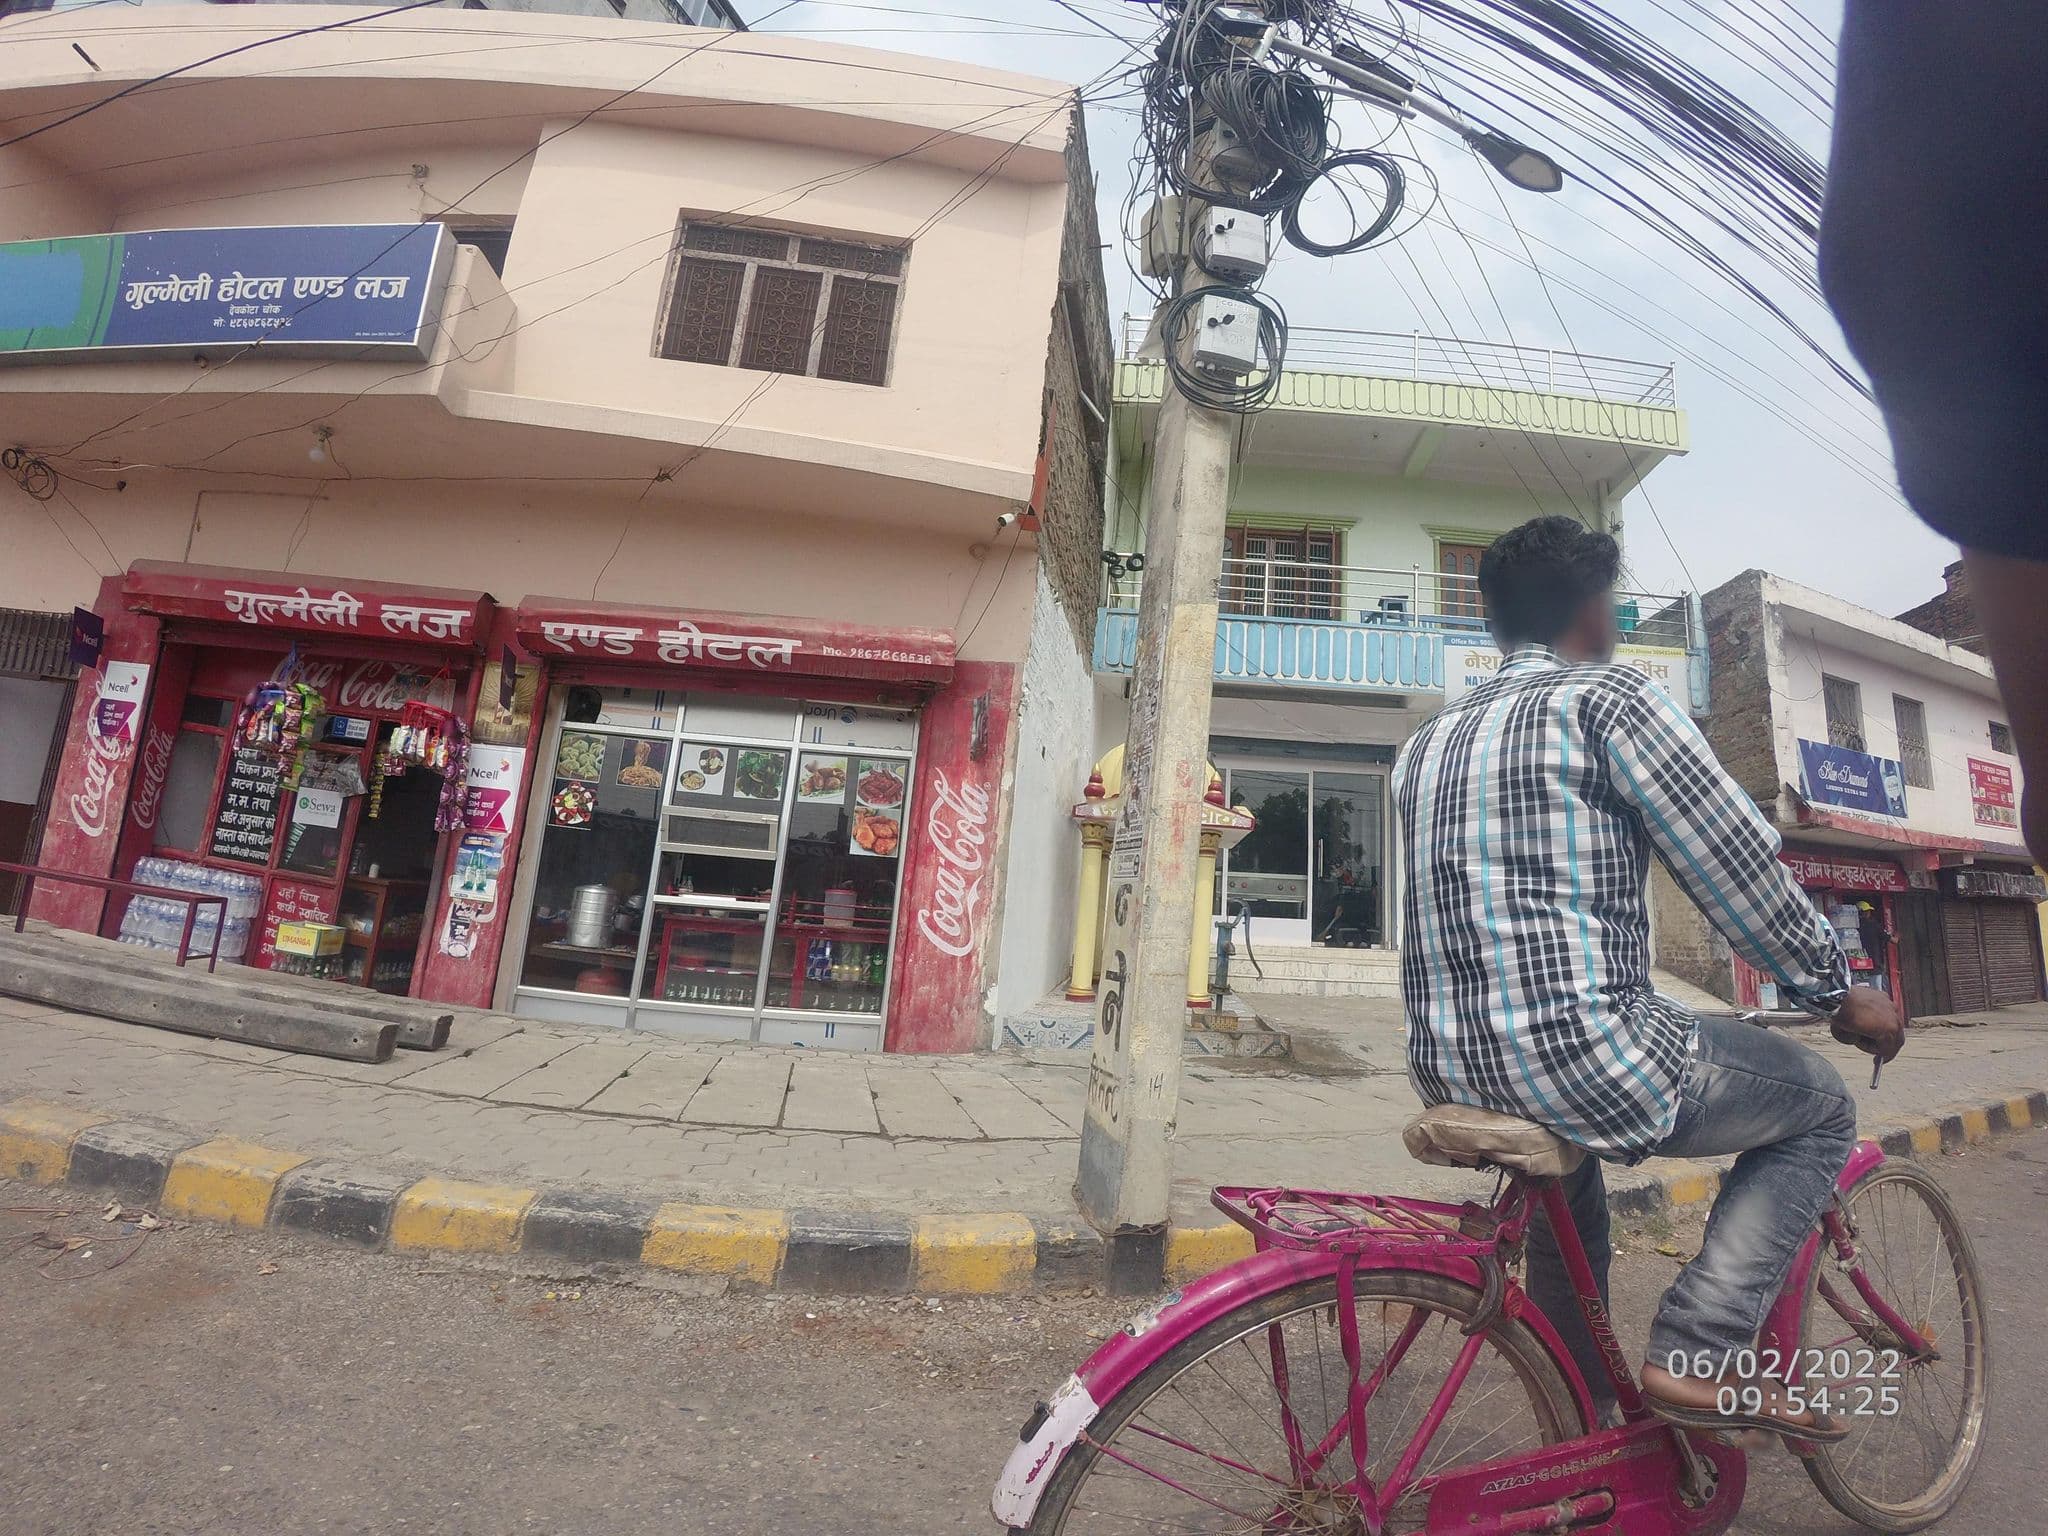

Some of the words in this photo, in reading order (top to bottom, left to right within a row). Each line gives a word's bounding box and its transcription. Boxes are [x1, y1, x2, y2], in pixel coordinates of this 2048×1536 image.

[125, 273, 213, 310] गुल्मेली
[217, 271, 287, 301] होटल
[293, 276, 348, 299] एण्ड
[354, 276, 410, 300] लज
[224, 587, 364, 628] गुल्मेली
[380, 604, 471, 638] लज
[541, 621, 643, 655] एण्ड
[657, 620, 802, 668] होटल
[108, 682, 130, 693] Ncell
[235, 760, 261, 777] चिकन
[470, 767, 499, 780] Ncell
[231, 777, 253, 791] मटन
[255, 781, 277, 798] फ्राई
[251, 797, 271, 812] तथा
[1580, 1295, 1633, 1384] ATLAS
